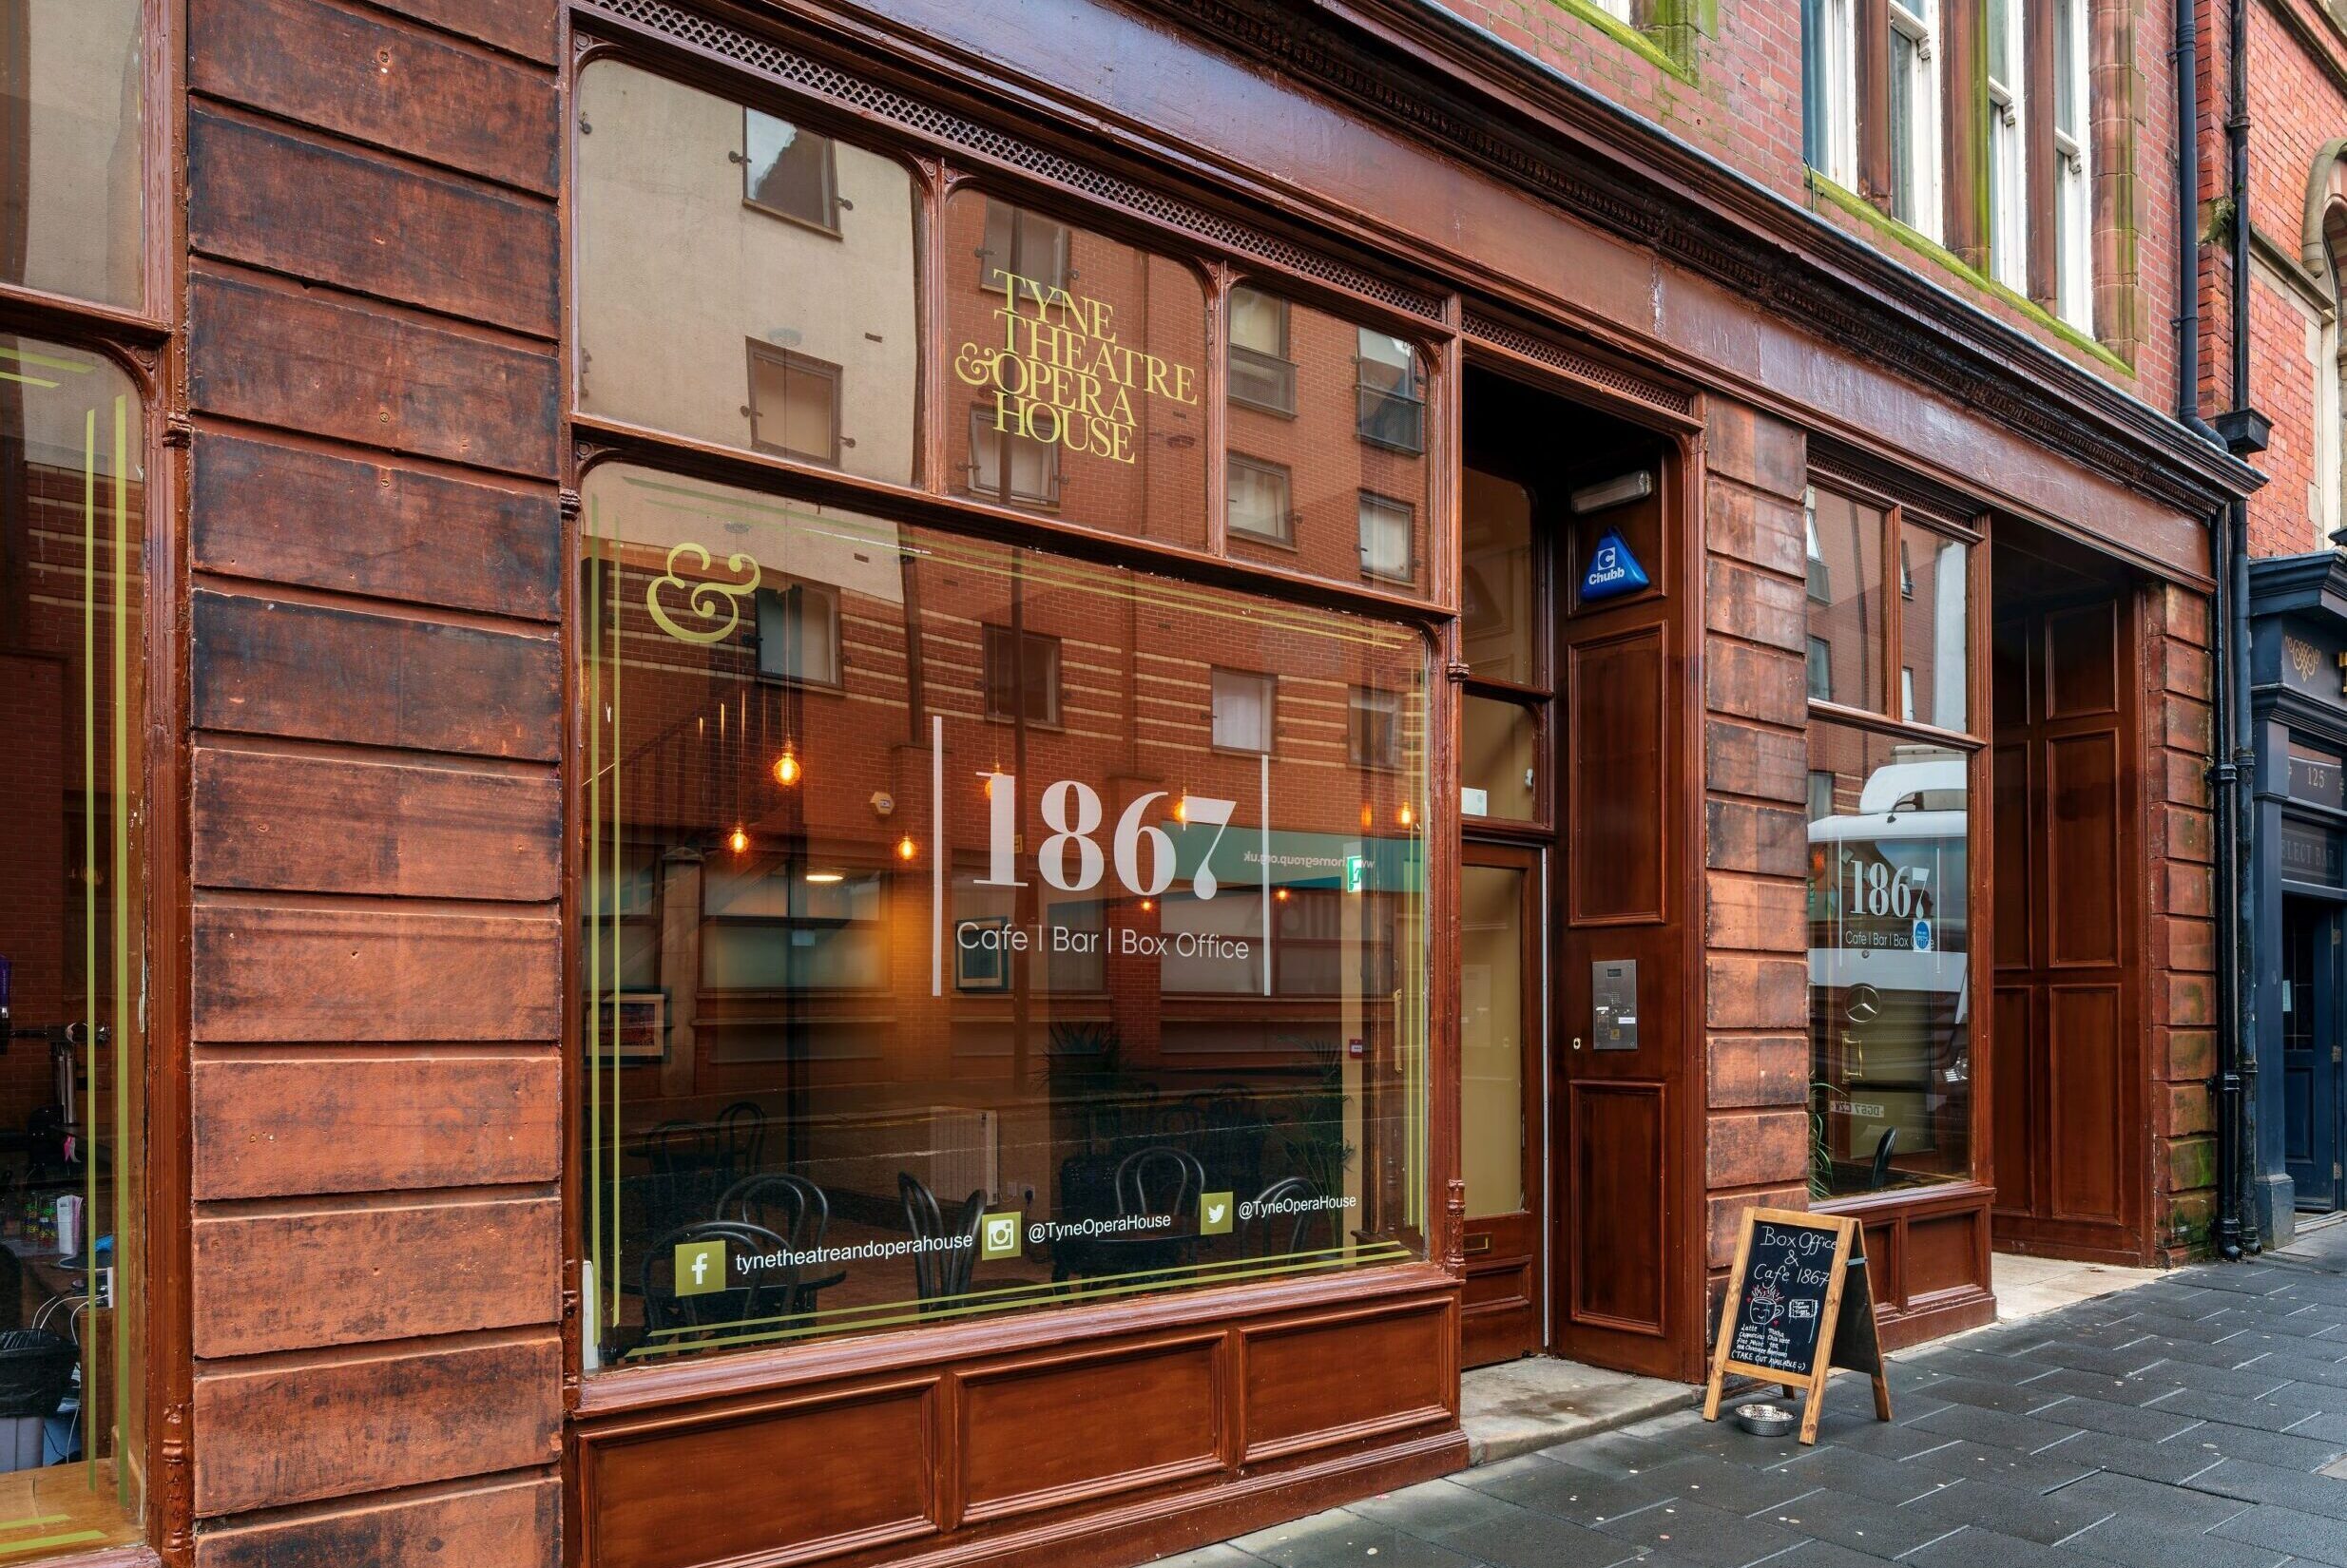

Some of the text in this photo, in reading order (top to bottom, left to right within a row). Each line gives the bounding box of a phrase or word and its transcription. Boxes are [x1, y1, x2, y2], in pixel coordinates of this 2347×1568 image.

[993, 269, 1116, 343] TYNE
[994, 310, 1198, 405] THEATRE
[992, 353, 1138, 427] OPERA
[992, 391, 1135, 464] HOUSE
[1588, 567, 1625, 585] Chubb
[646, 543, 760, 643] &
[2307, 766, 2325, 788] 125
[973, 772, 1236, 899] 1867
[1850, 860, 1930, 919] 1867
[957, 922, 1028, 951] Cafe
[1053, 926, 1099, 953] Bar
[1122, 929, 1168, 955] Box
[1176, 932, 1249, 960] Office
[1845, 930, 1867, 944] Cafe
[1873, 932, 1887, 946] Bar
[1894, 934, 1909, 947] Box
[1239, 1195, 1357, 1220] @TyneOperaHouse
[1029, 1215, 1171, 1243] @TyneOperaHouse
[1760, 1226, 1837, 1255] Box Office
[735, 1233, 973, 1274] tynetheatreandoperahouse
[1784, 1249, 1799, 1267] &
[1754, 1263, 1831, 1289] Cafe 1867
[1755, 1353, 1768, 1363] OUT
